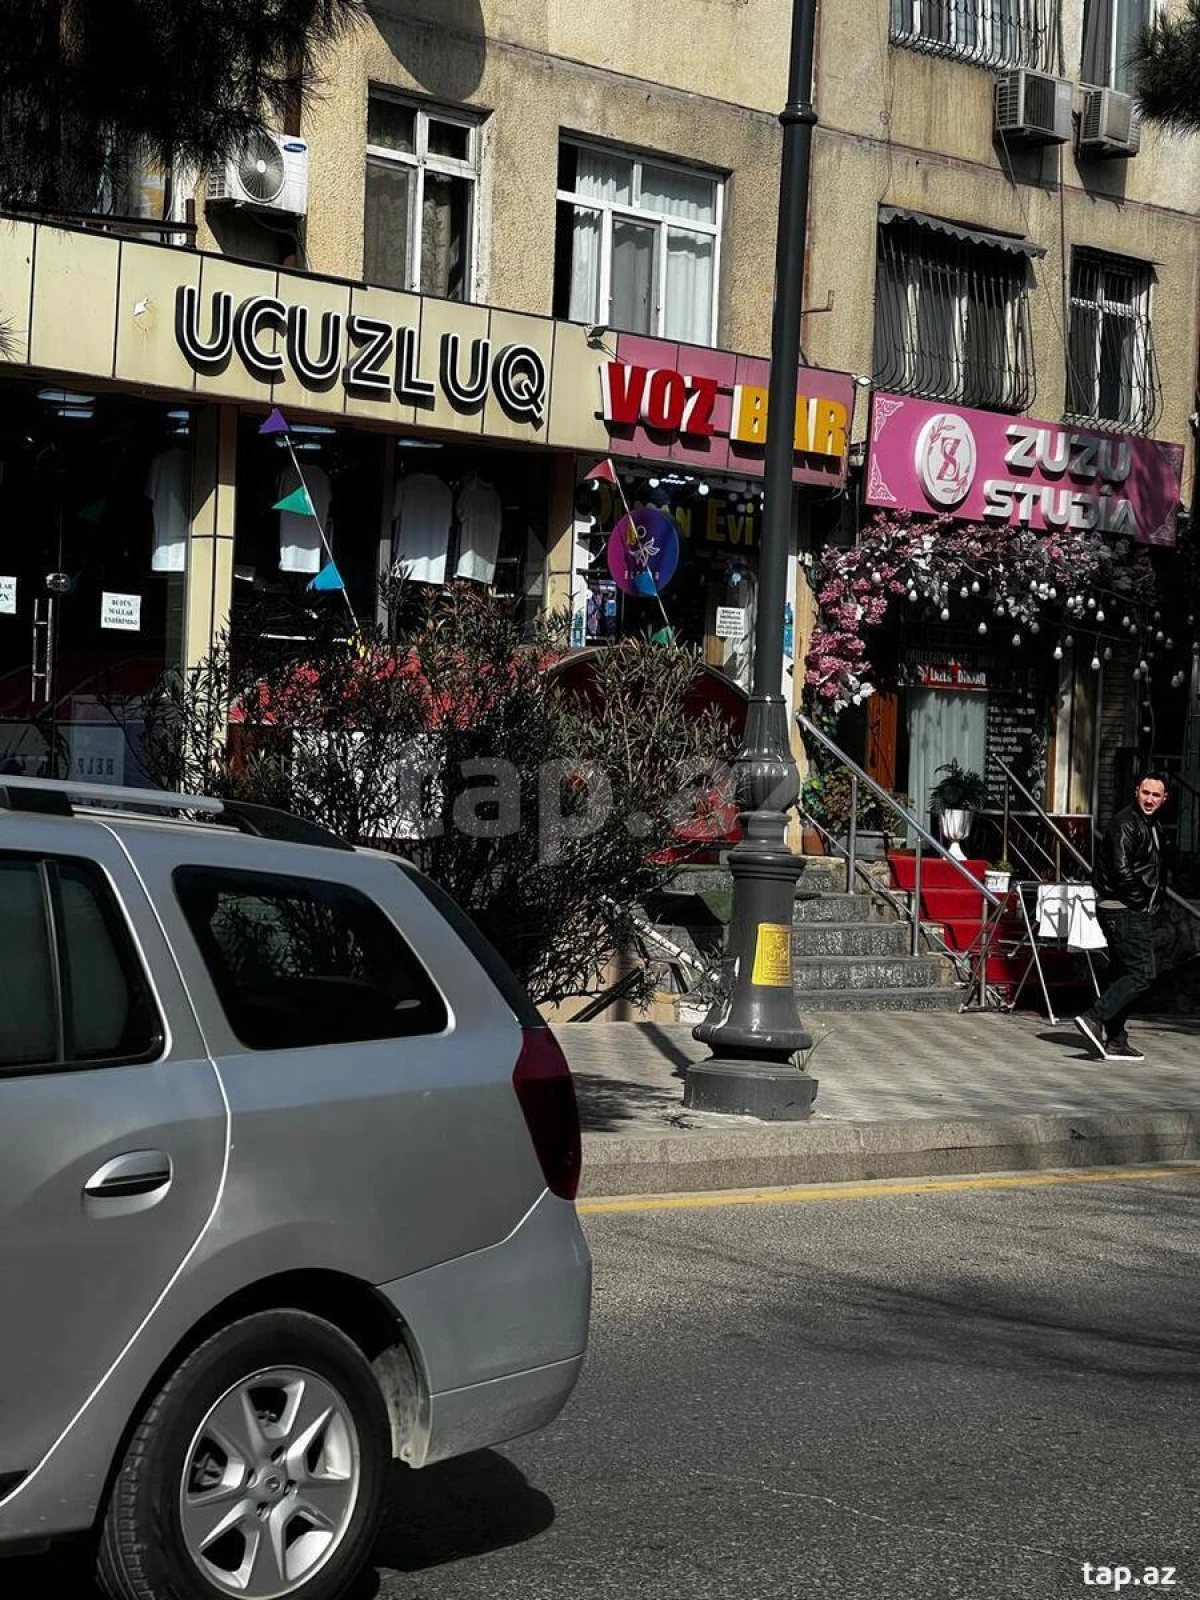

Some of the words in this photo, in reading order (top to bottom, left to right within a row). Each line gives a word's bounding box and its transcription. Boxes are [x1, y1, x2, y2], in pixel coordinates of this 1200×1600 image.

[175, 284, 545, 426] UCUZLUQ
[600, 362, 718, 436] VOZ
[1005, 424, 1131, 482] ZUZU
